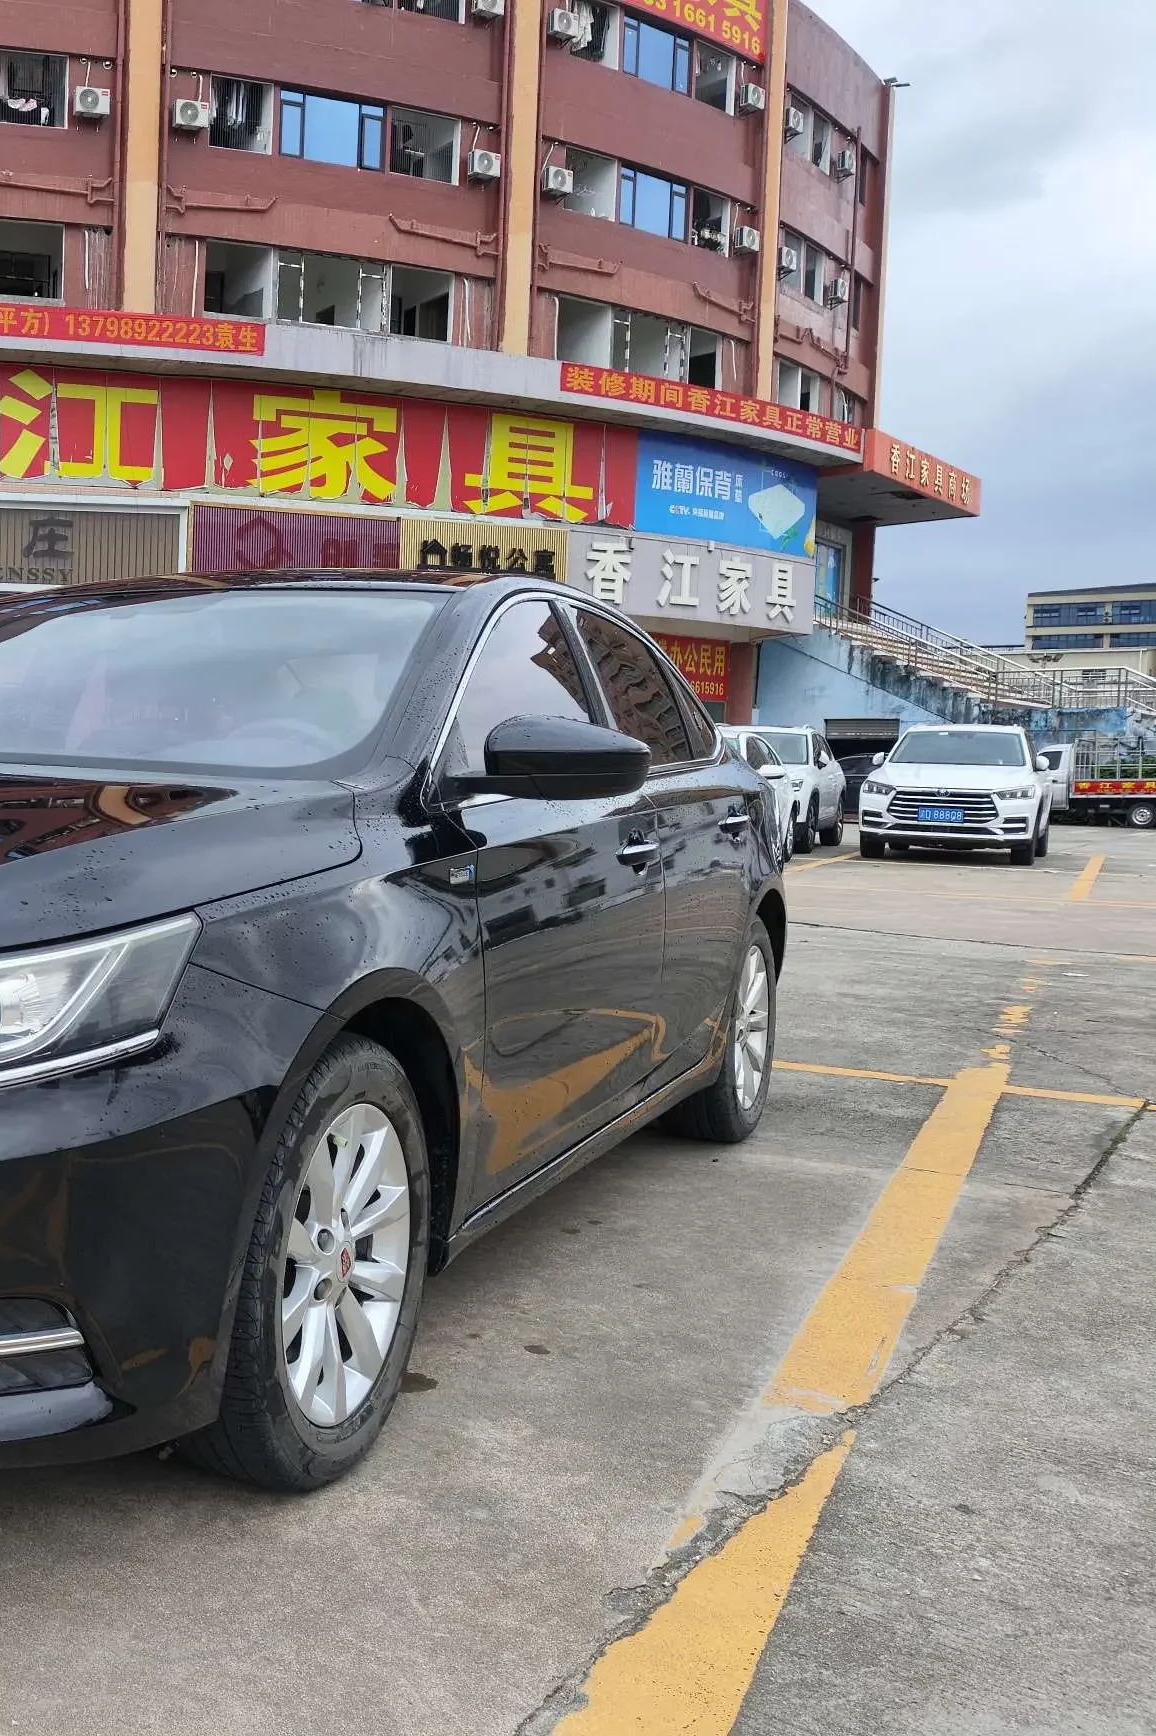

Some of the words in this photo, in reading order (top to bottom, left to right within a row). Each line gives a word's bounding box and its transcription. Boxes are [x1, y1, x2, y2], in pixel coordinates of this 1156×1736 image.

[722, 20, 760, 55] 5916
[566, 366, 860, 450] 装修期间香江家具正常营业
[890, 443, 970, 505] 香江家具商场
[585, 541, 797, 623] 香江家具
